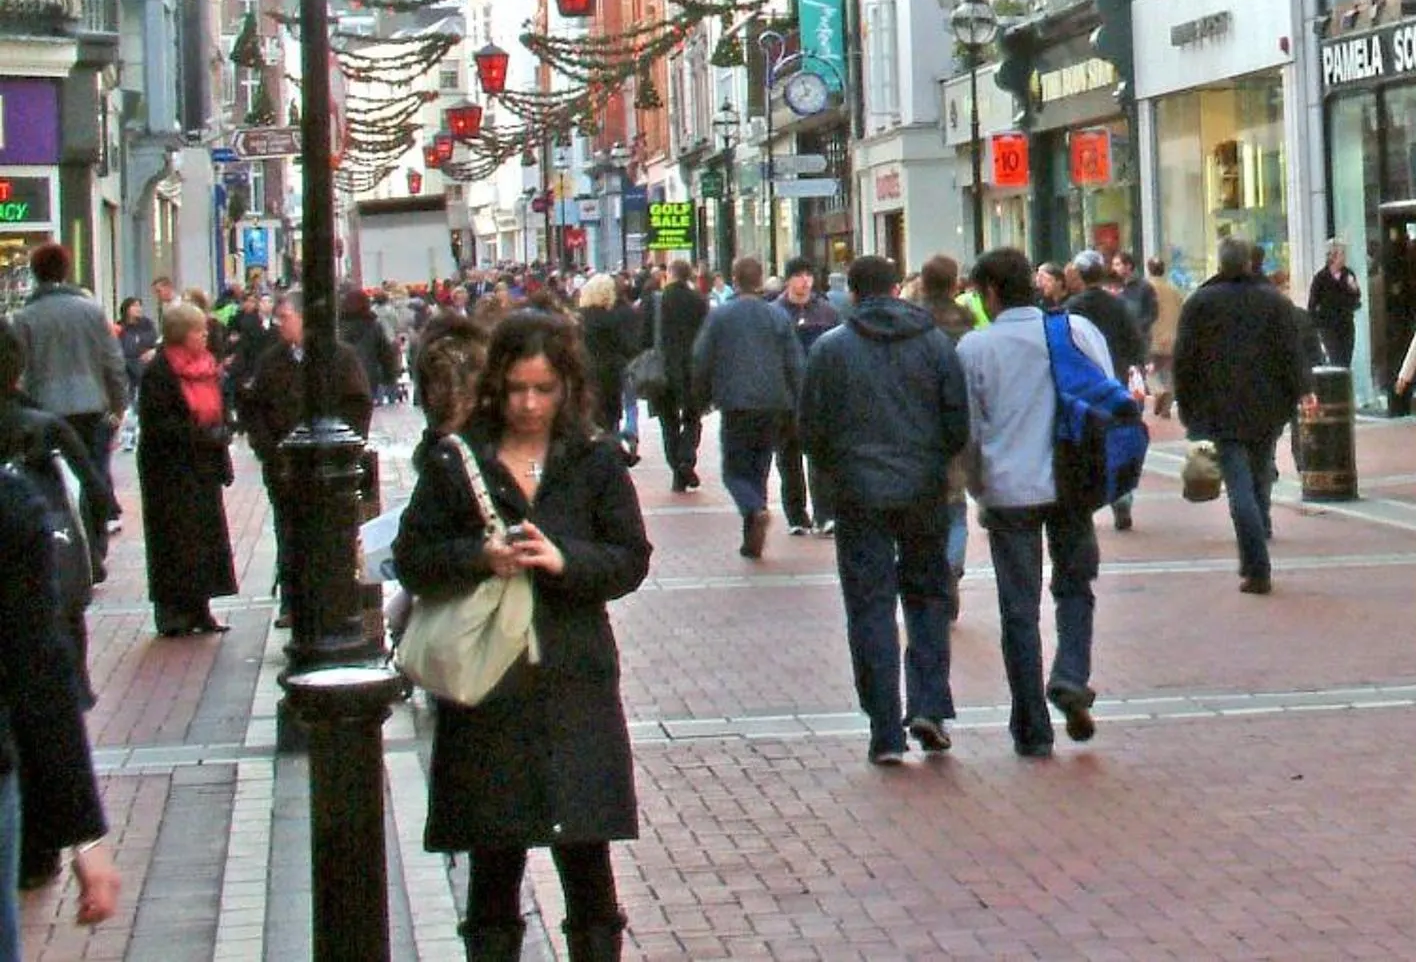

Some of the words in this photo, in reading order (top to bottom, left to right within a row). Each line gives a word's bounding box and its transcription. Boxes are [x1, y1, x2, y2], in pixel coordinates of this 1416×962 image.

[1321, 34, 1385, 86] PAMELA
[649, 203, 691, 216] GOLF
[650, 215, 690, 228] SALE
